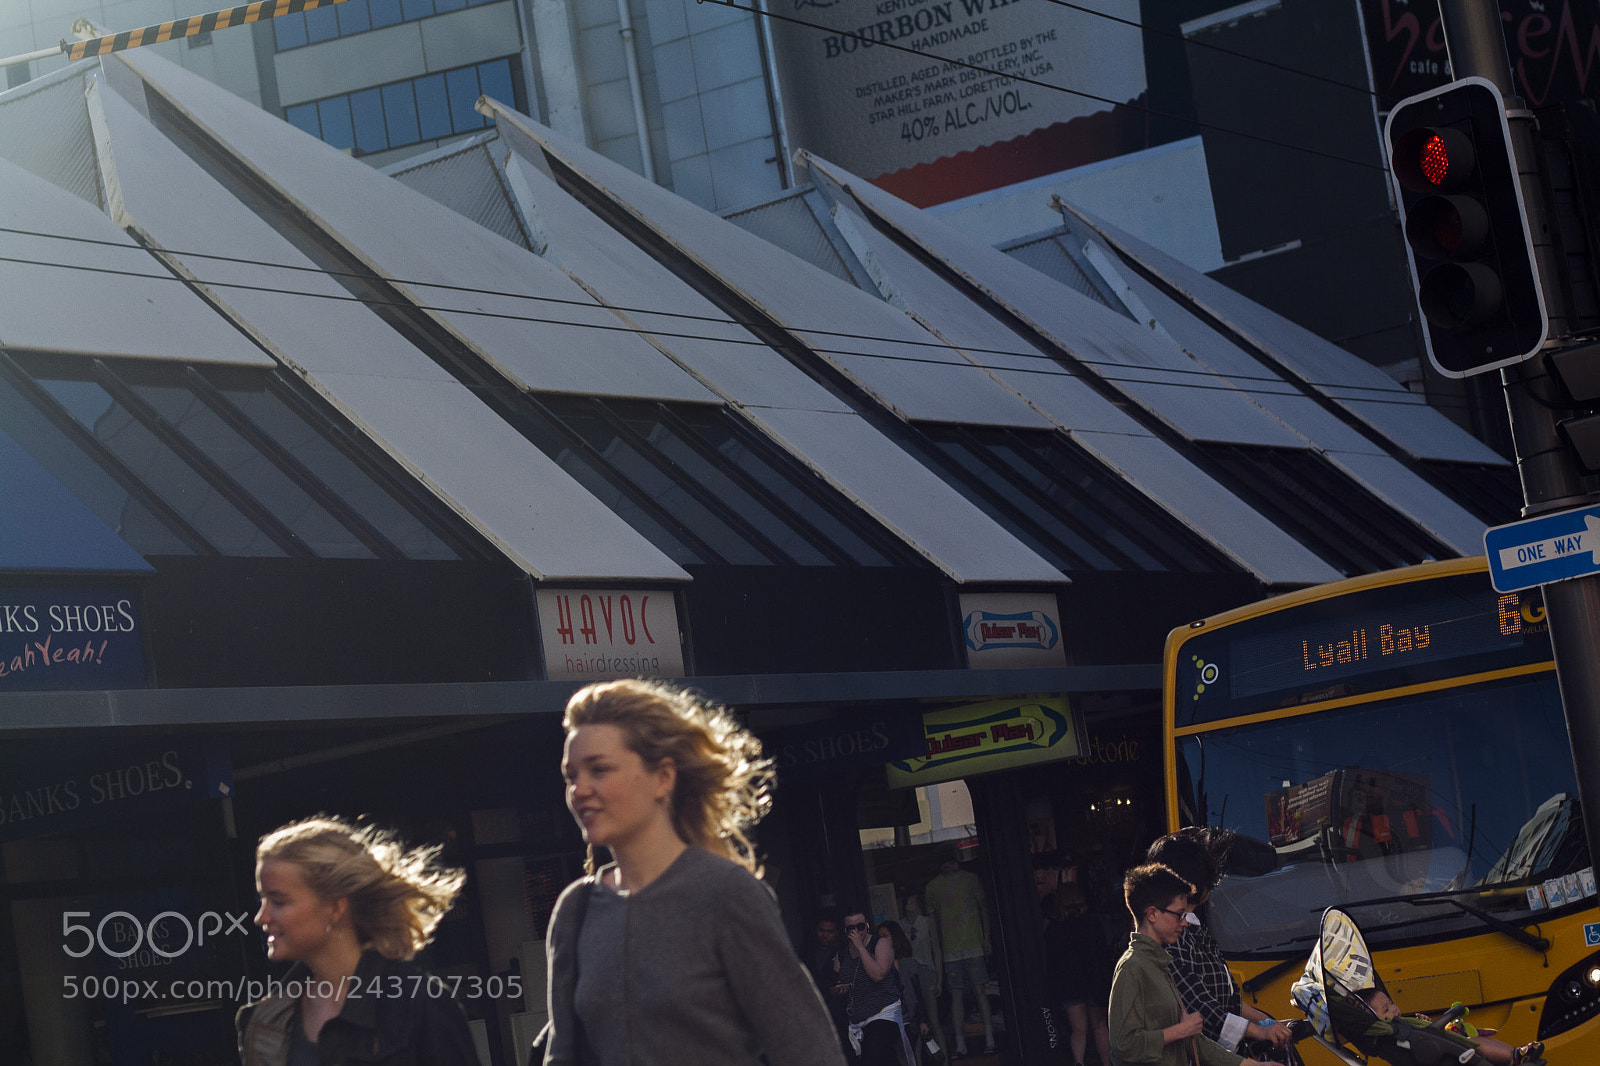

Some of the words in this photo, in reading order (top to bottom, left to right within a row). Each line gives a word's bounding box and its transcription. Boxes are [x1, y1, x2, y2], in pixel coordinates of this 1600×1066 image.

[822, 2, 953, 59] BOURBON
[911, 18, 989, 51] HANDMADE
[856, 75, 909, 98] DISTILLED,
[911, 67, 939, 82] AGED
[943, 57, 965, 74] AND
[968, 42, 1017, 65] BOTTLED
[1021, 37, 1034, 50] BY
[1036, 29, 1057, 45] THE
[874, 86, 921, 108] MAKER'S
[924, 76, 957, 94] MARK
[960, 56, 1020, 82] DISTILLERY,
[1022, 50, 1044, 64] INC.
[1410, 60, 1438, 74] cafe
[869, 108, 895, 124] STAR
[898, 102, 921, 116] HILL
[923, 92, 957, 109] FARM,
[960, 76, 1011, 98] LORETTO,
[1031, 62, 1054, 76] USA
[901, 116, 940, 143] 40%
[1517, 544, 1546, 562] ONE
[1554, 535, 1581, 554] WAY
[0, 605, 39, 633] KS
[48, 599, 135, 633] SHOES
[556, 594, 656, 645] HAVOC
[981, 623, 1016, 642] Pulsar
[1017, 623, 1041, 642] Play
[1302, 628, 1368, 671] Lyall
[1379, 623, 1432, 656] Bay
[1498, 594, 1521, 635] 6
[565, 652, 660, 674] hairdressing
[804, 722, 890, 764] SHOES
[926, 732, 987, 759] Pulsar
[990, 723, 1034, 743] Play
